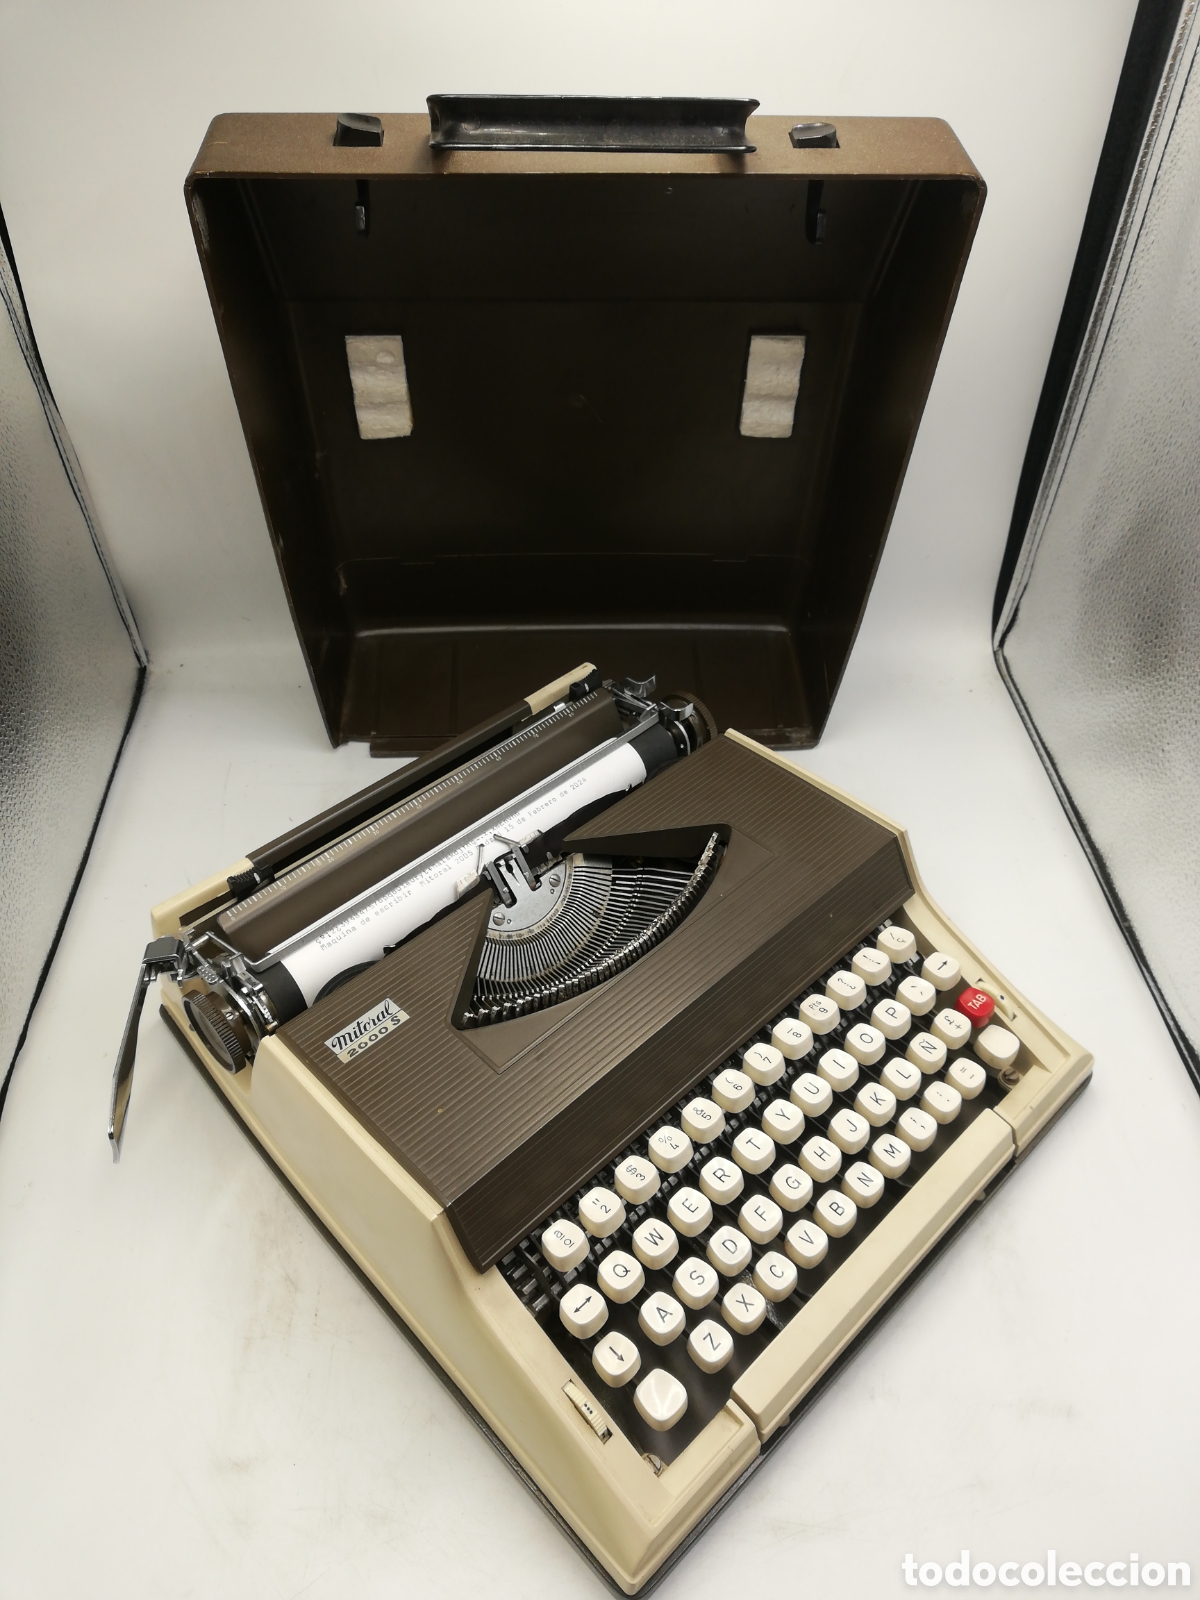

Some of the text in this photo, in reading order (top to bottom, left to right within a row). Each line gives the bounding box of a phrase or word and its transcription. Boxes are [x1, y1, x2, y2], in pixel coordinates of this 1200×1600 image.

[320, 926, 357, 951] Maquina
[360, 916, 371, 926] de
[374, 890, 412, 916] escribir
[420, 864, 453, 887] Mitoral
[504, 823, 515, 833] 15
[516, 816, 527, 825] de
[559, 788, 569, 798] de
[569, 777, 587, 791] 2024
[967, 993, 987, 1010] TAB
[885, 1006, 898, 1019] P
[331, 999, 393, 1050] Mitoral
[346, 1015, 401, 1058] 2000 S
[859, 1032, 874, 1044] O
[918, 1038, 938, 1055] Ñ
[762, 1056, 772, 1064] 7
[832, 1059, 846, 1070] I
[895, 1068, 912, 1080] L
[732, 1083, 743, 1091] 6
[803, 1081, 820, 1095] U
[869, 1091, 887, 1106] K
[701, 1112, 712, 1121] 5
[775, 1108, 791, 1120] Y
[846, 1118, 858, 1133] J
[657, 1134, 673, 1144] %
[669, 1142, 680, 1150] 4
[745, 1137, 761, 1150] T
[813, 1146, 831, 1162] H
[882, 1143, 902, 1159] M
[635, 1172, 646, 1181] 3
[712, 1167, 731, 1183] R
[856, 1171, 874, 1188] N
[785, 1176, 802, 1190] G
[600, 1204, 612, 1214] 2
[681, 1197, 699, 1214] E
[828, 1201, 845, 1217] B
[753, 1205, 767, 1222] F
[643, 1227, 665, 1247] W
[798, 1229, 815, 1245] V
[721, 1238, 738, 1255] D
[612, 1263, 631, 1278] Q
[689, 1270, 705, 1286] S
[769, 1264, 785, 1279] C
[735, 1293, 755, 1313] X
[655, 1306, 673, 1324] A
[702, 1332, 722, 1351] Z
